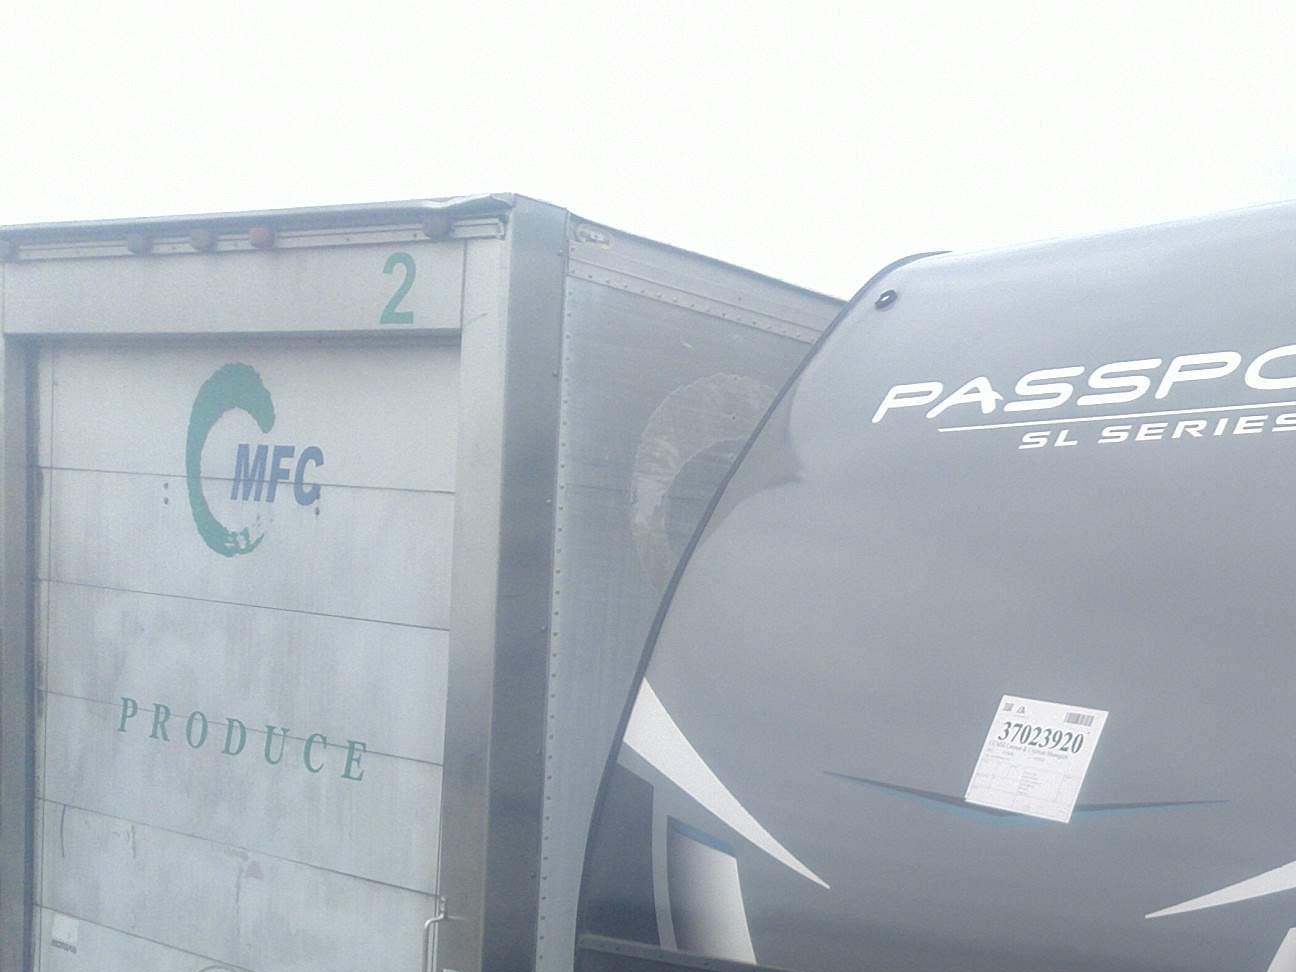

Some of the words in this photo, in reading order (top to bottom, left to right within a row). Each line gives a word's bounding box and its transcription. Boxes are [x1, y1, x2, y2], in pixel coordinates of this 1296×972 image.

[379, 252, 418, 326] 2
[1018, 429, 1079, 450] SL
[230, 443, 324, 506] MFC
[117, 696, 368, 782] PRODUCE
[998, 721, 1084, 755] 37023920
